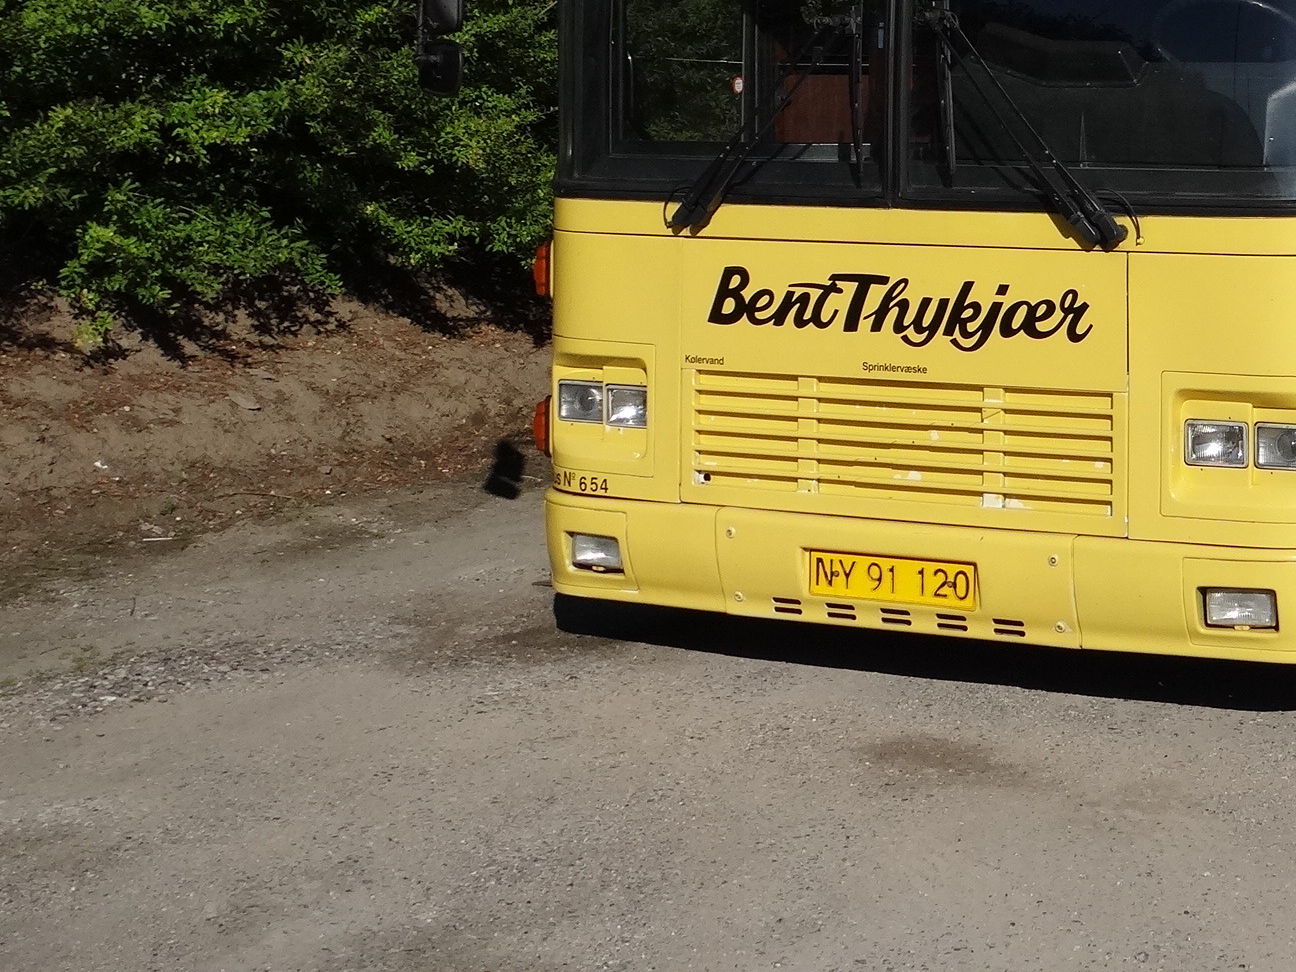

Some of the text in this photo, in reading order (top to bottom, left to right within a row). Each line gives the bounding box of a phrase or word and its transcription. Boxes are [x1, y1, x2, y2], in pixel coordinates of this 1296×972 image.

[707, 266, 1094, 353] Bent Thykjær
[862, 361, 928, 375] Sprinklervæske
[579, 476, 608, 493] 654
[815, 557, 970, 600] NY 91 120
